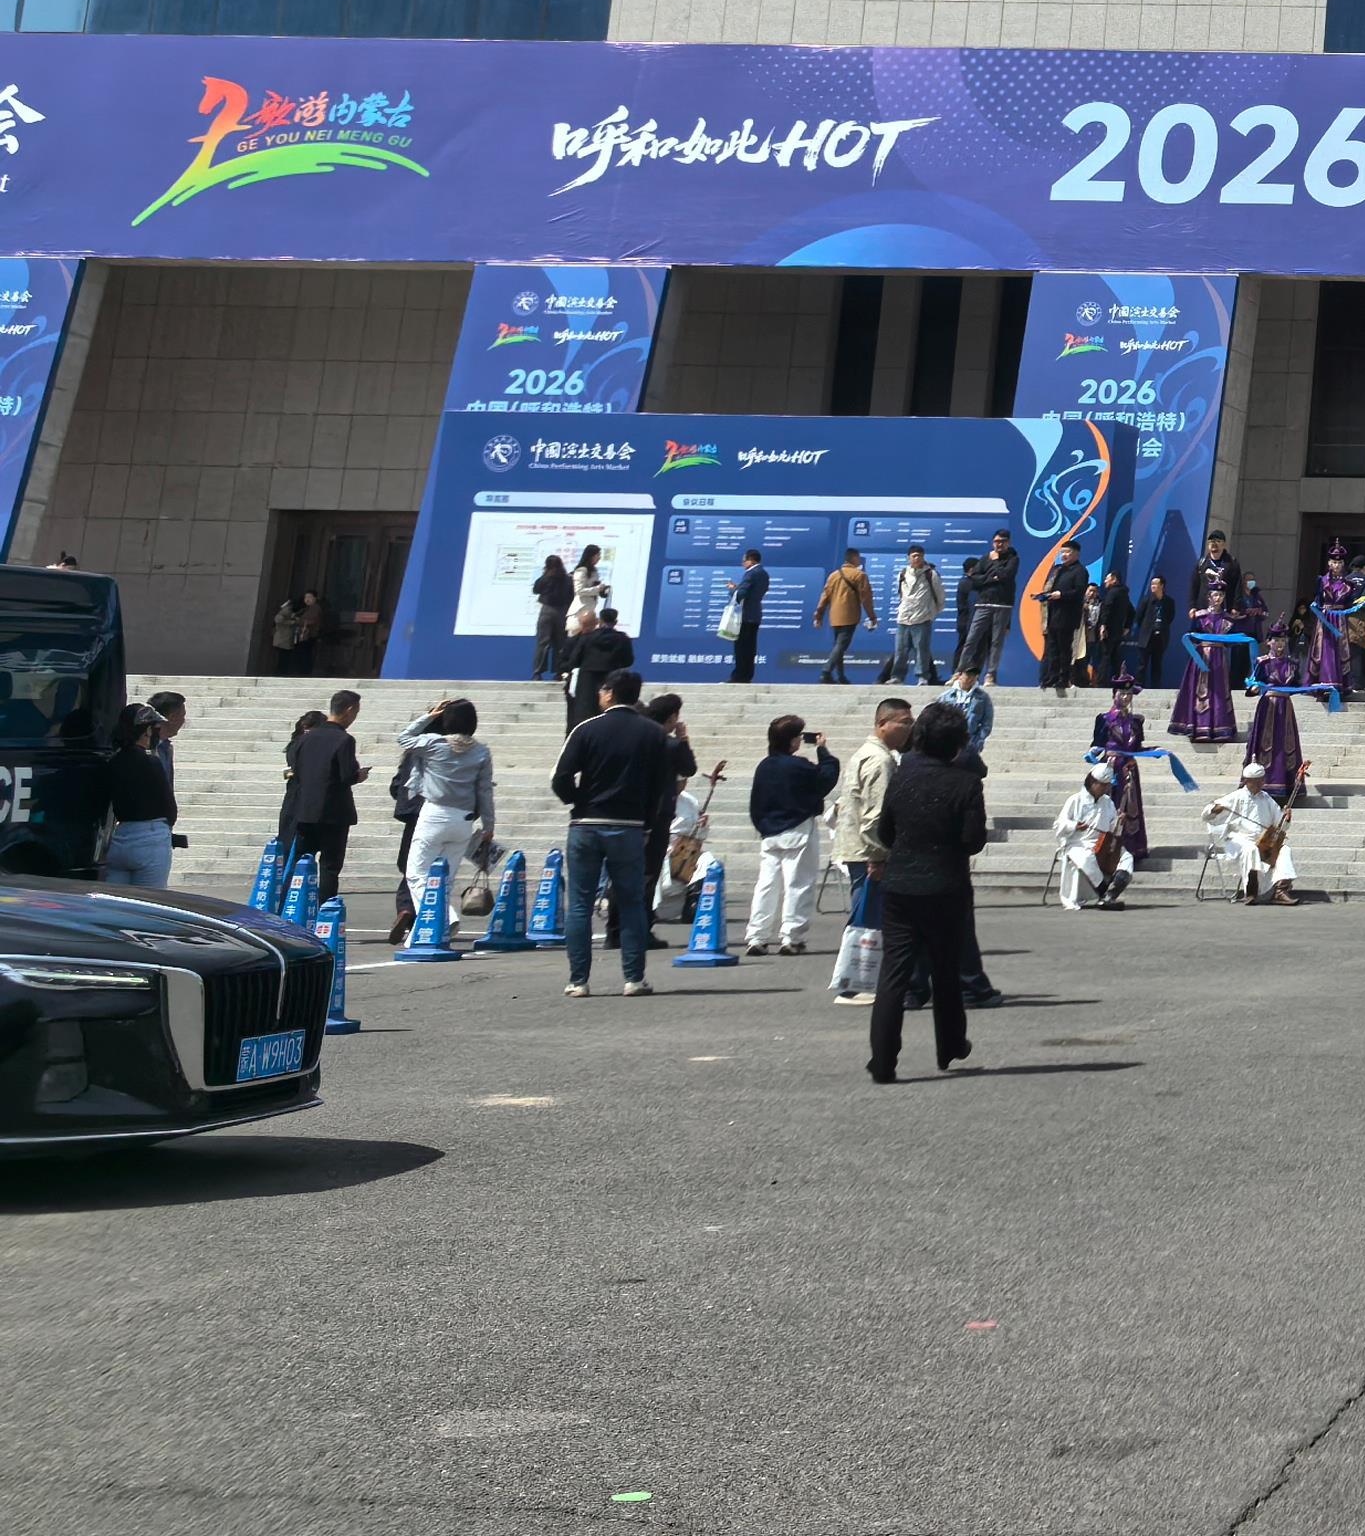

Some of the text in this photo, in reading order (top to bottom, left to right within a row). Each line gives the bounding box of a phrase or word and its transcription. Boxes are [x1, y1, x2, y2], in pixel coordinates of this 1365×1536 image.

[245, 90, 415, 139] 歌游内蒙古
[237, 129, 414, 153] GE YOU NEI MENG GU
[505, 368, 586, 396] 2026
[1078, 379, 1156, 405] 2026
[414, 891, 439, 944] 日丰管
